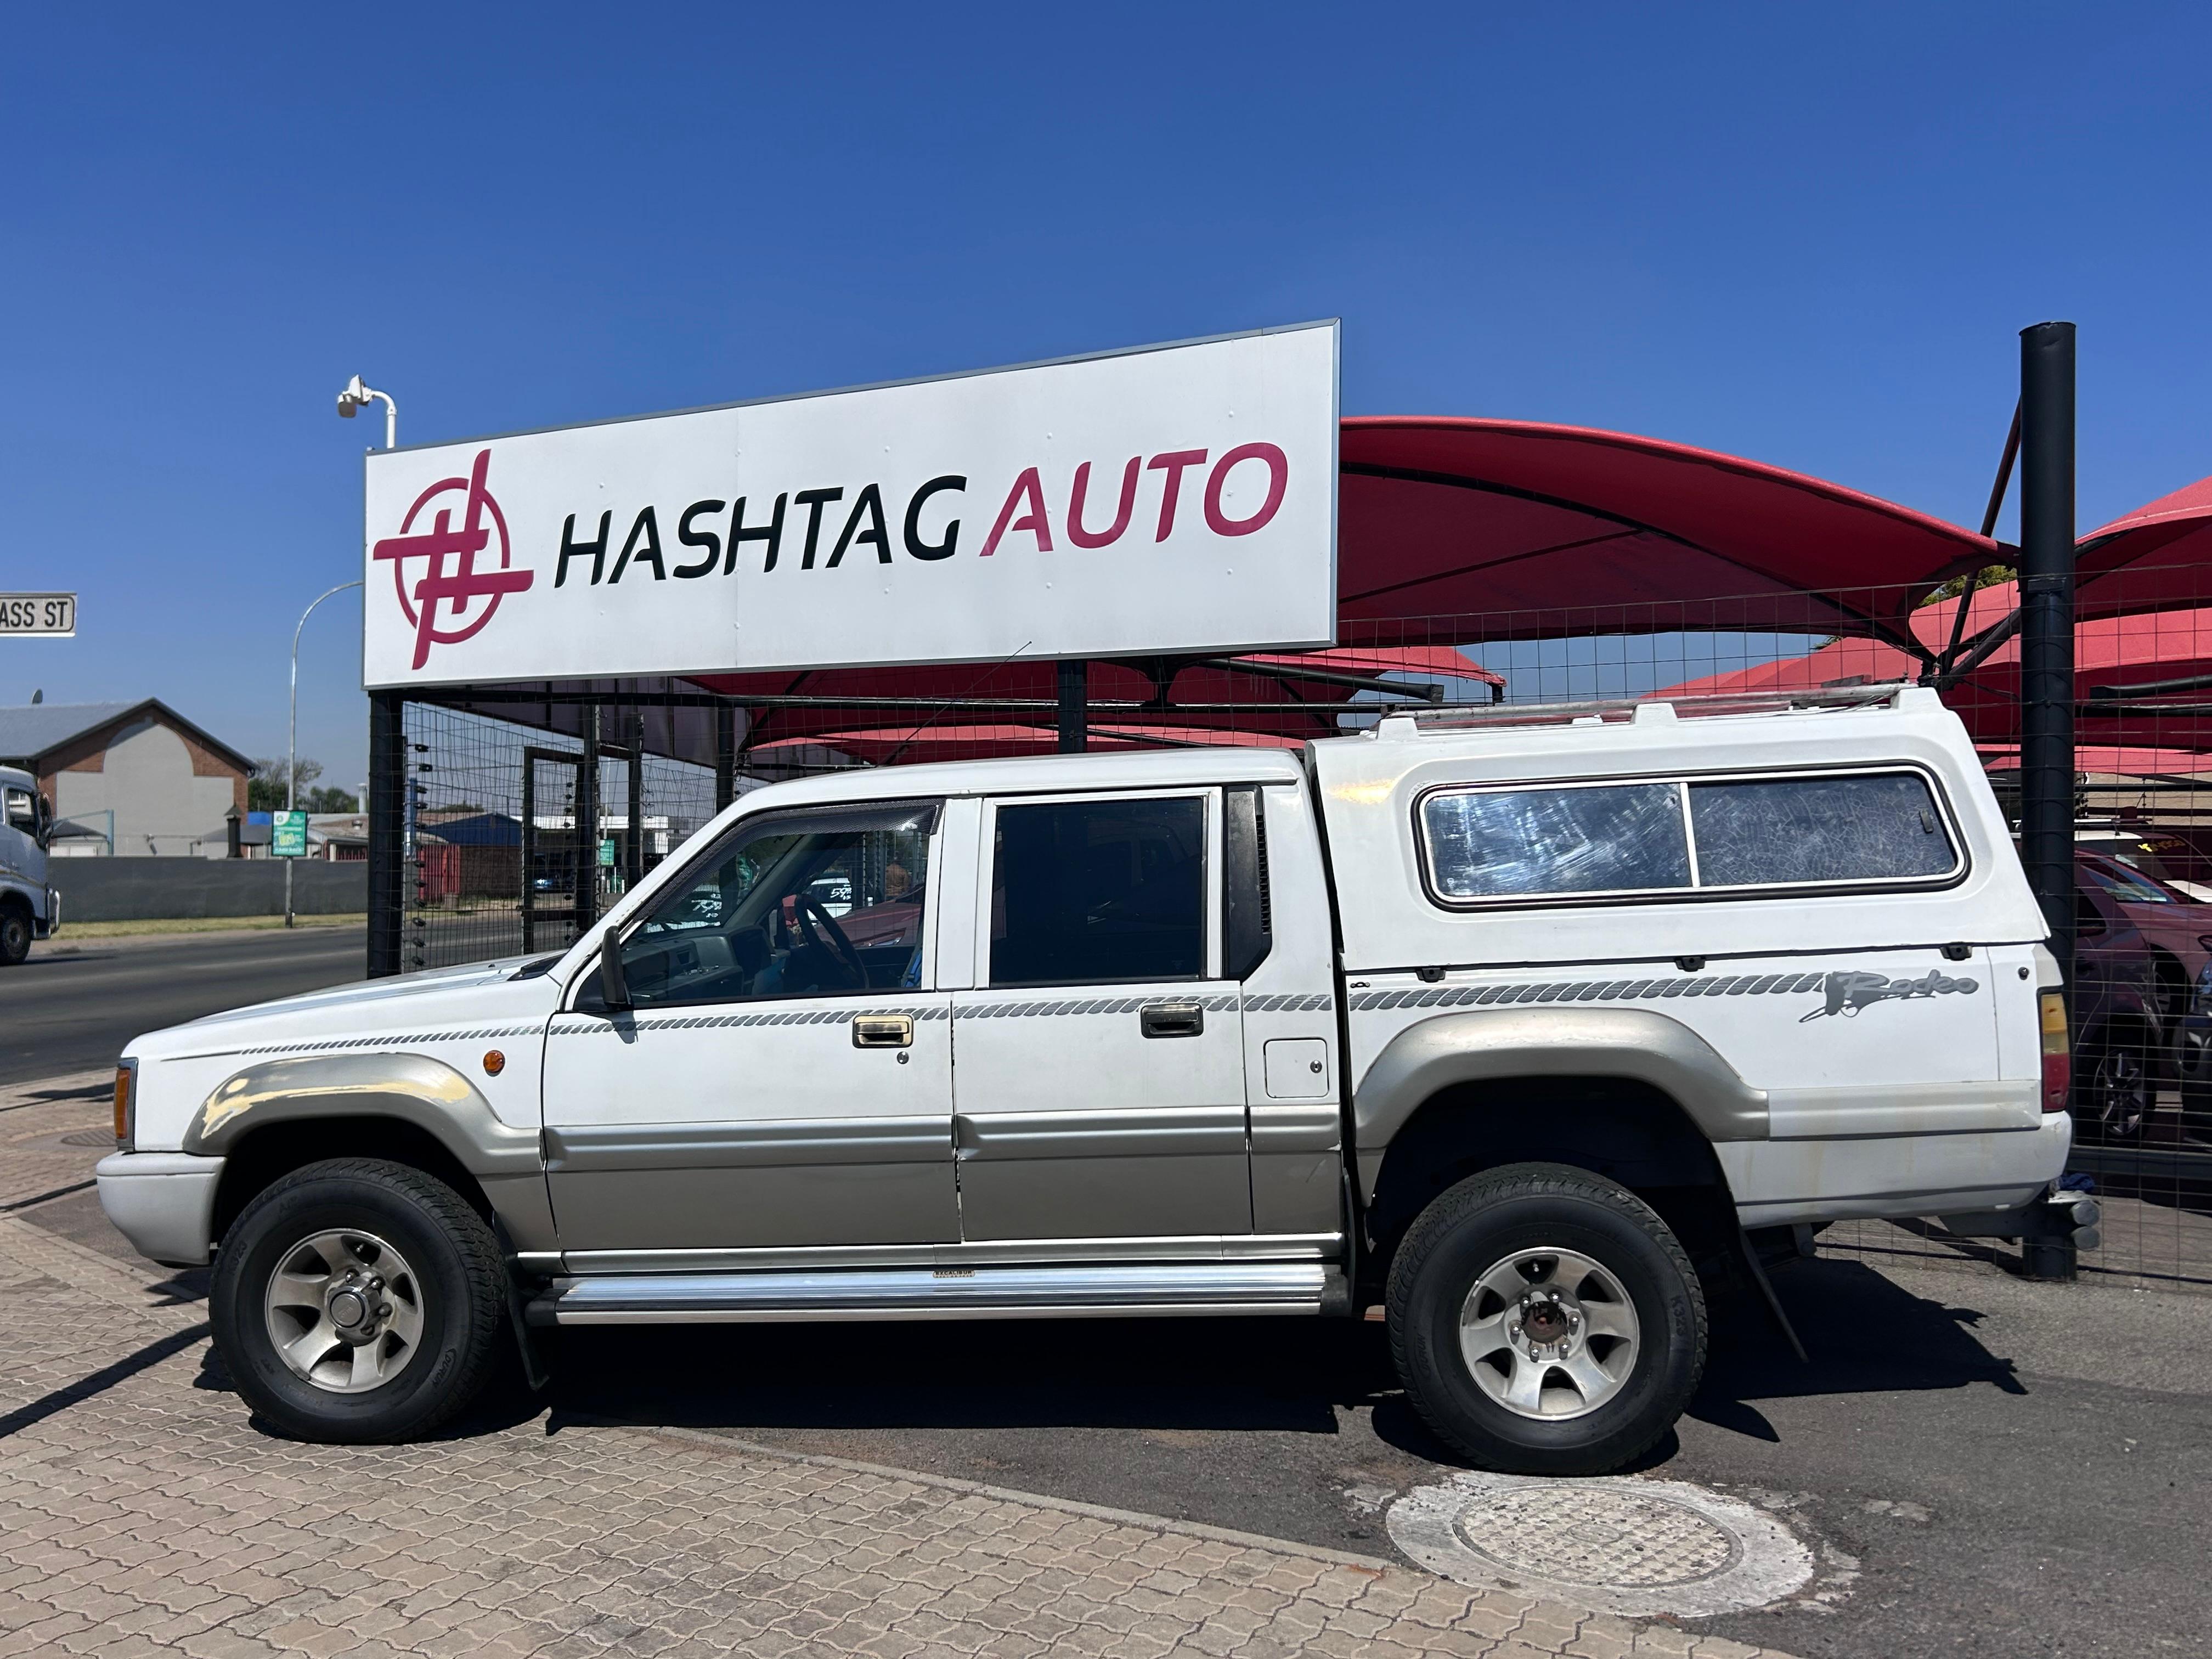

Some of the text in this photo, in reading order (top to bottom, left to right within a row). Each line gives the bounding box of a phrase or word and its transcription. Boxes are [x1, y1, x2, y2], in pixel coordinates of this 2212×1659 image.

[555, 442, 1288, 588] HASHTAG AUTO
[44, 601, 68, 628] ST
[1837, 969, 1979, 999] Rodeo
[432, 1354, 452, 1389] DURUN
